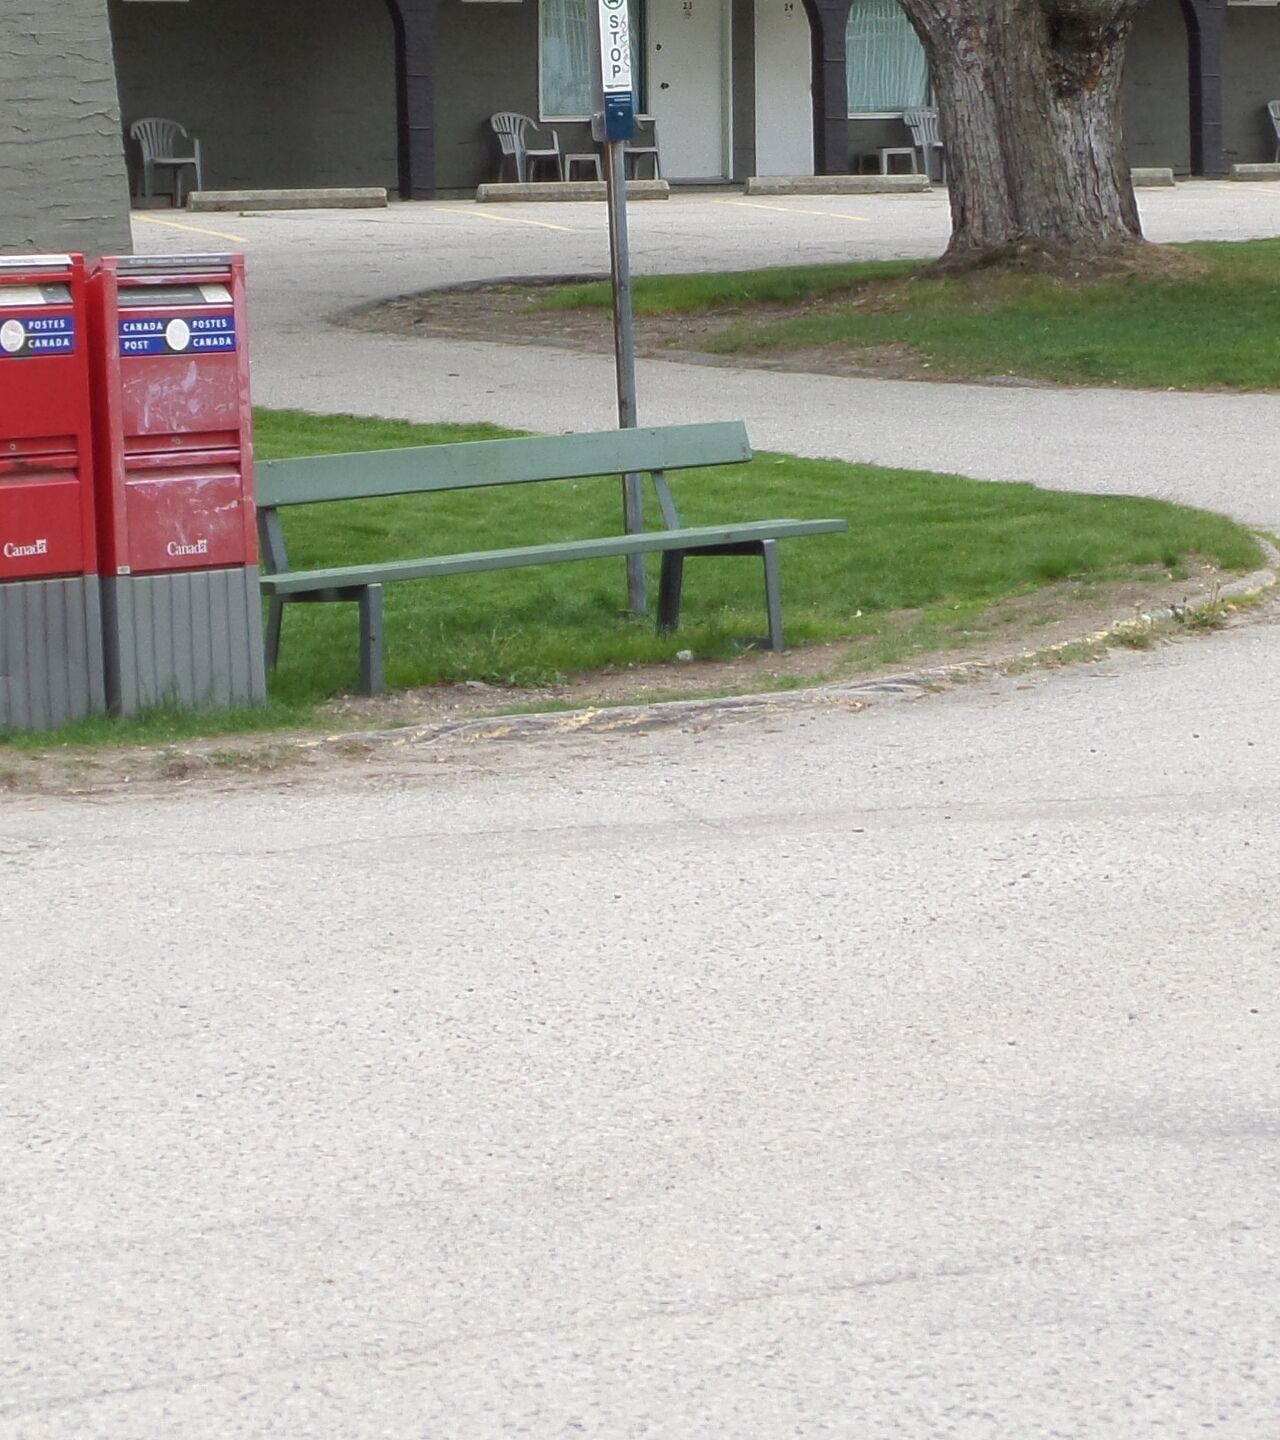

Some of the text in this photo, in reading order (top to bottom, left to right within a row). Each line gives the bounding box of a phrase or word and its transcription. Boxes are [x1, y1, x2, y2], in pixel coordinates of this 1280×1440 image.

[609, 14, 622, 79] STOP
[28, 319, 66, 330] POSTES
[122, 321, 163, 332] CANADA
[192, 318, 228, 329] POSTES
[27, 338, 70, 349] CANADA
[124, 340, 149, 350] POST
[193, 336, 232, 347] CANADA
[3, 540, 47, 558] Canada
[167, 540, 208, 556] Canada
